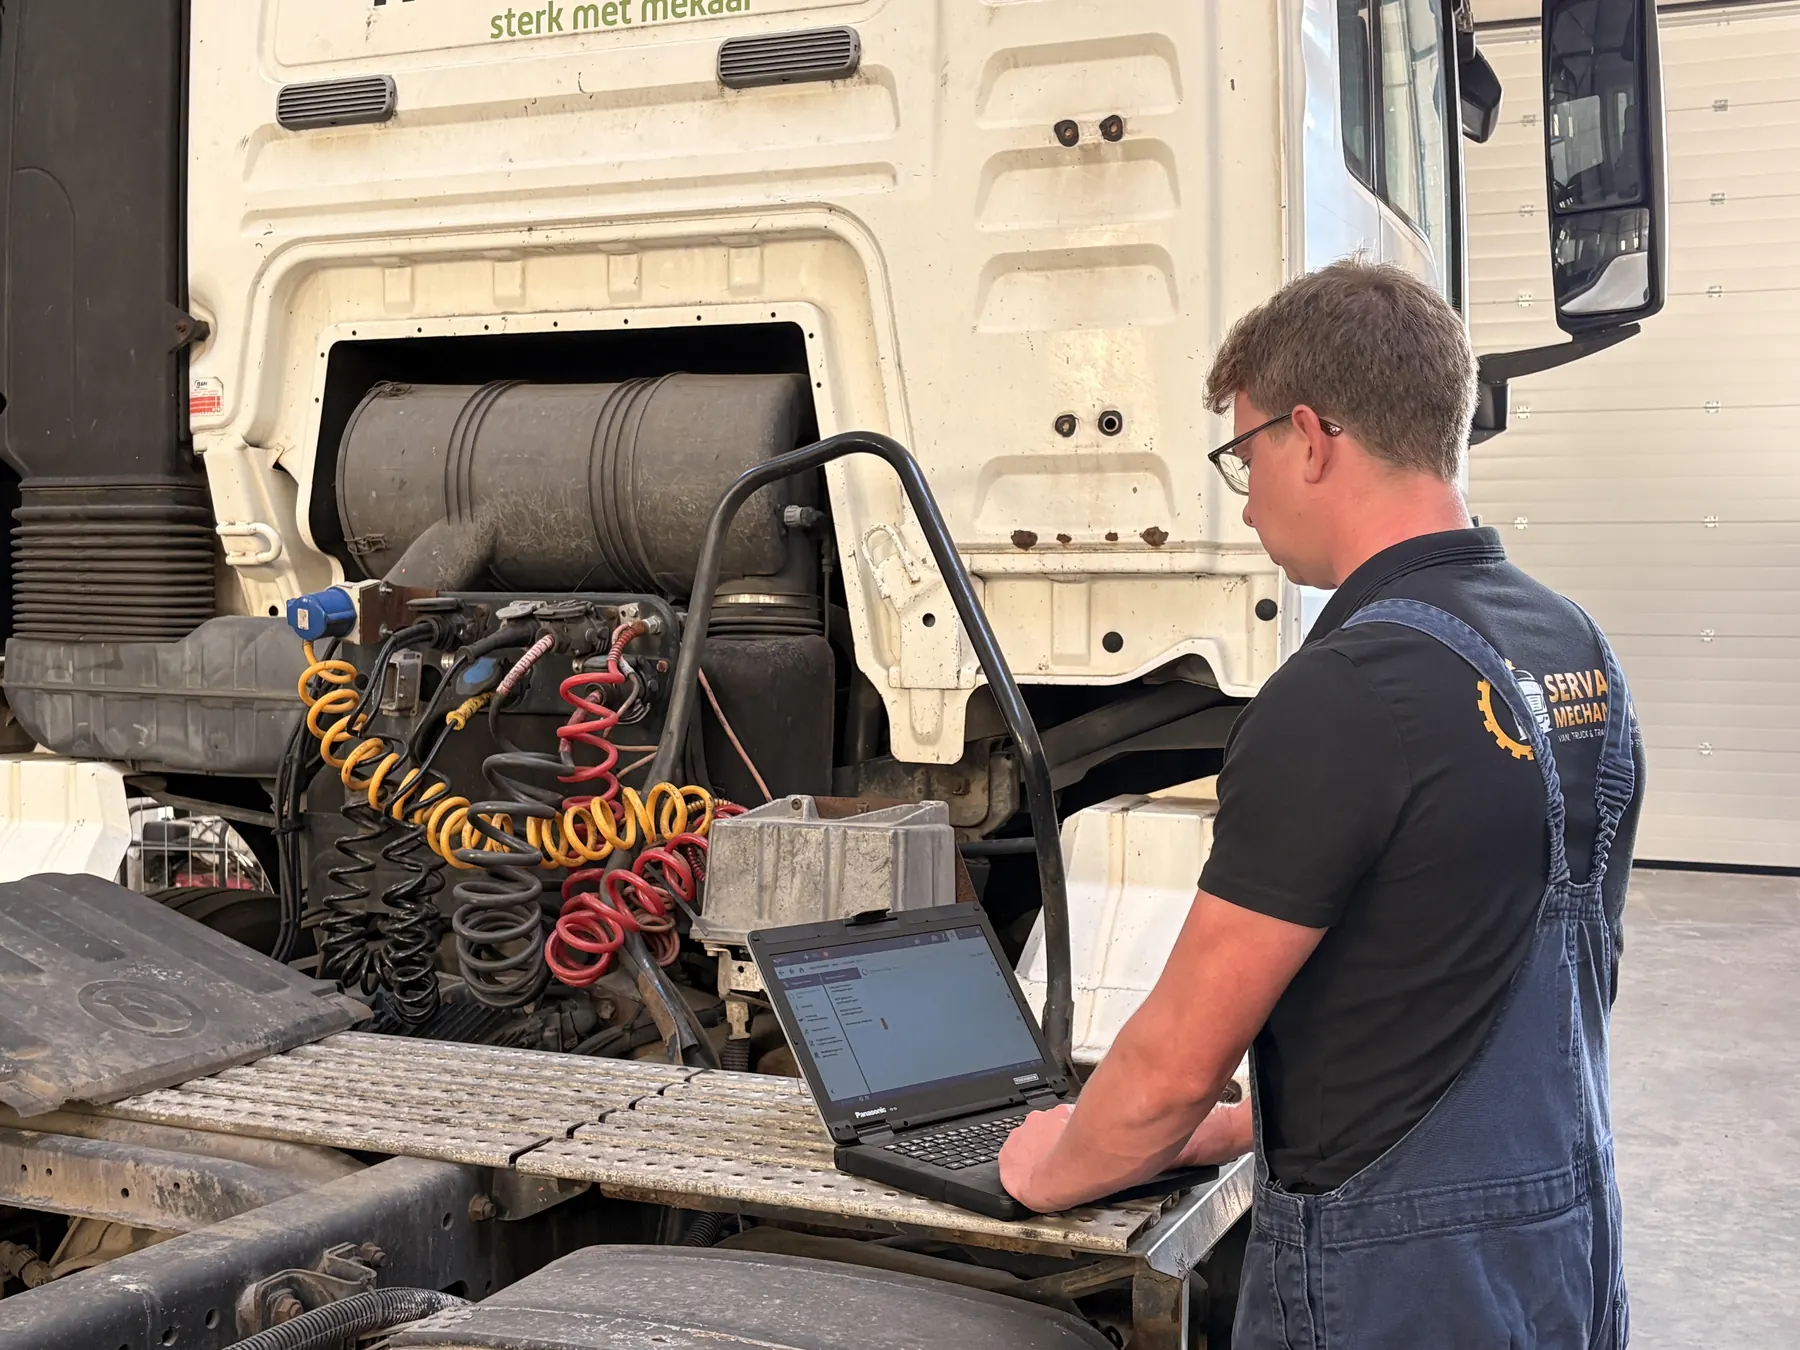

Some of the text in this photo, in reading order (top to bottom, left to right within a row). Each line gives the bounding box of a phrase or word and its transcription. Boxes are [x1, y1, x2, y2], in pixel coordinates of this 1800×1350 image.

[490, 1, 564, 39] sterk
[572, 0, 631, 30] met
[1543, 669, 1608, 703] SERVA
[854, 1106, 887, 1119] Panasonic
